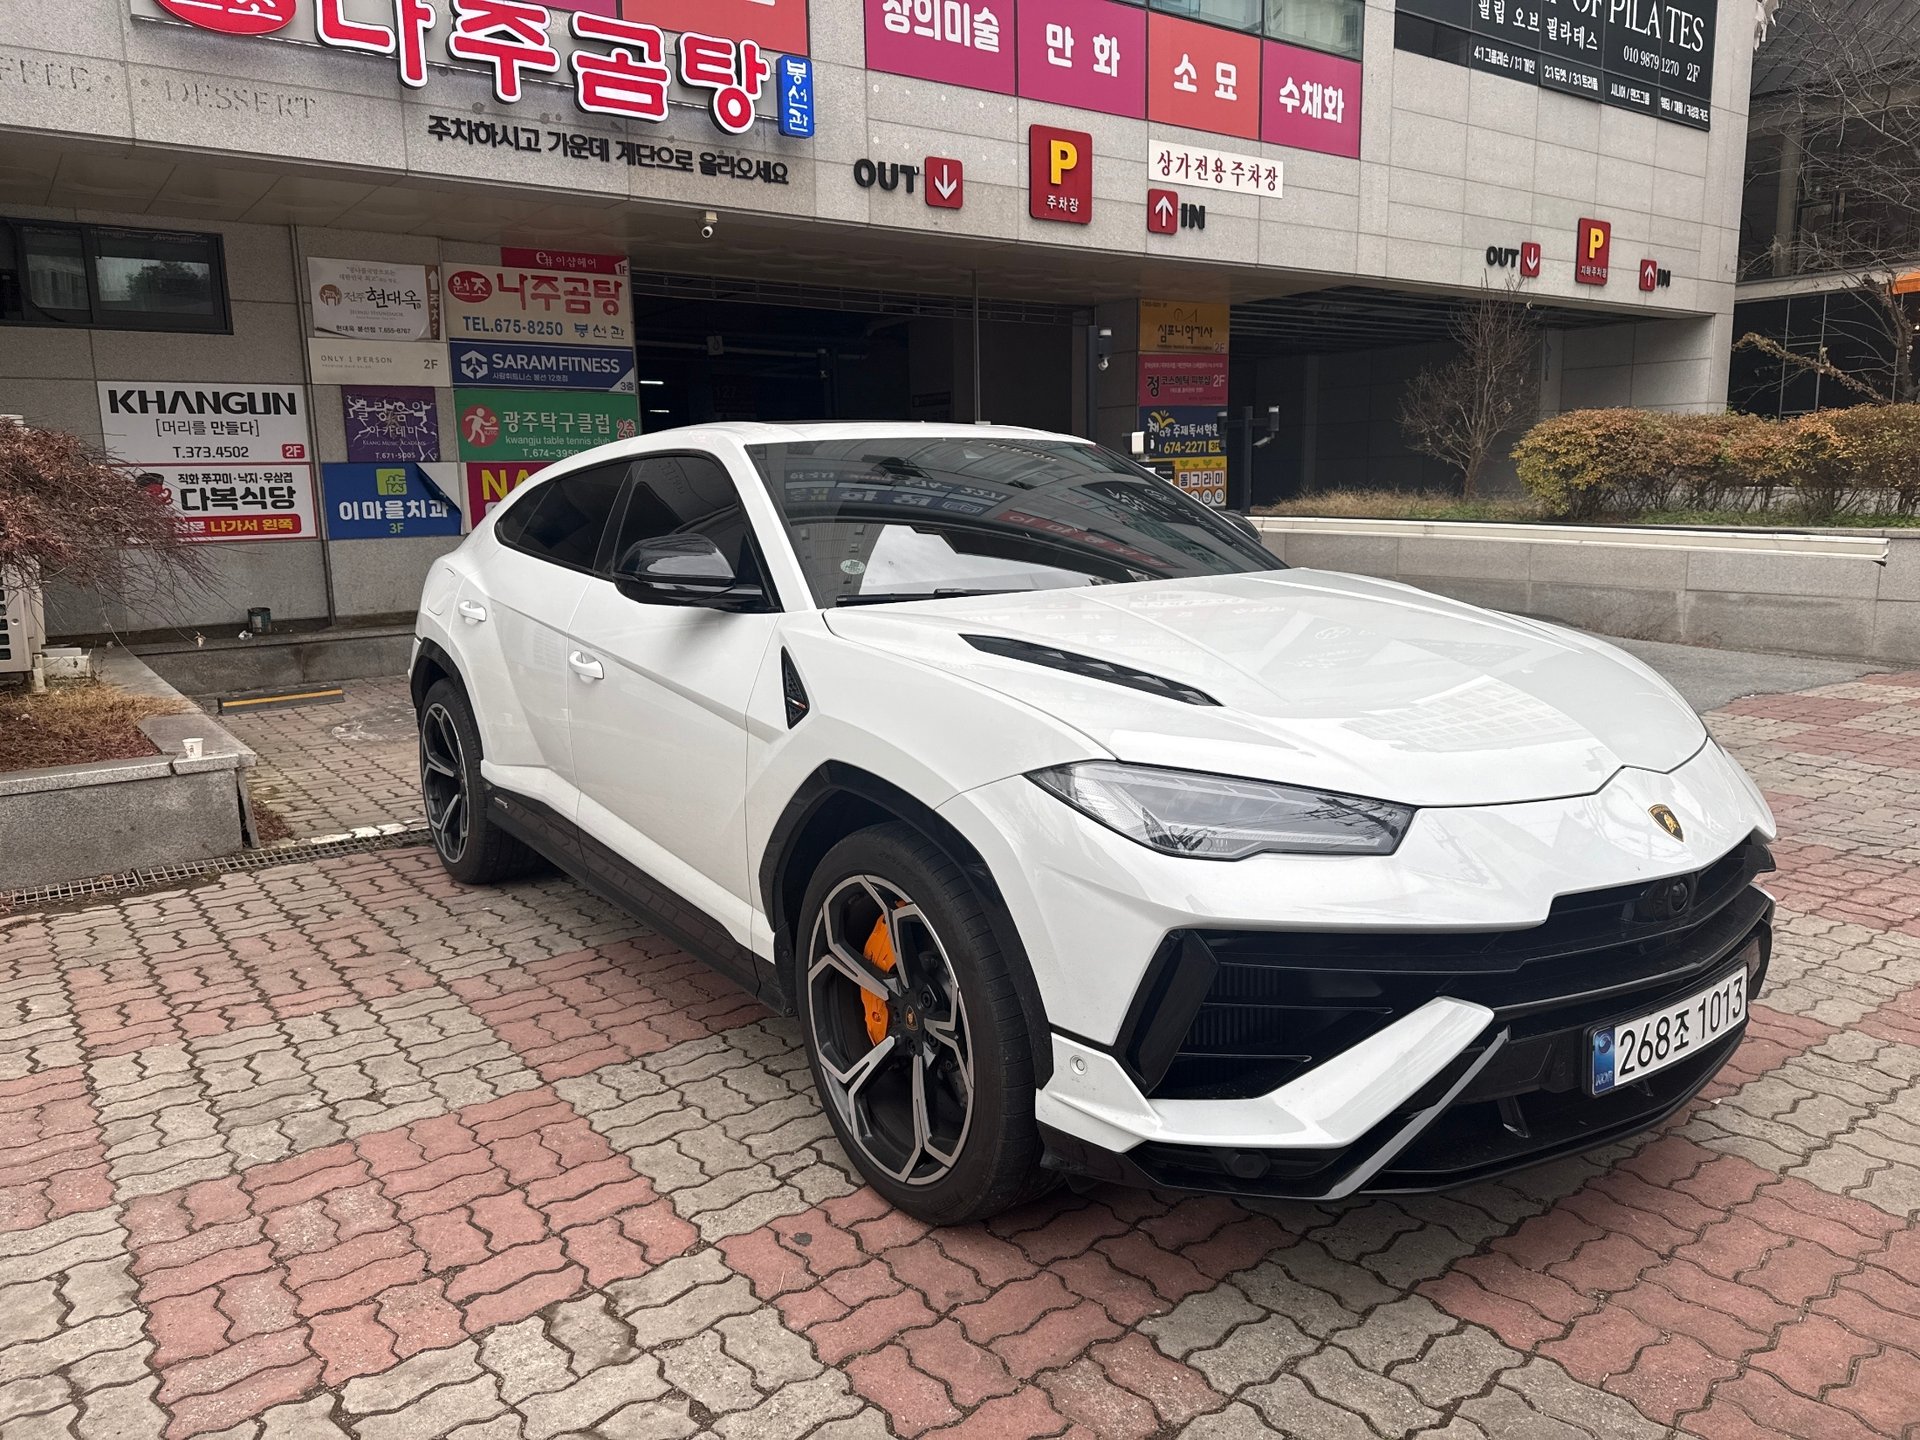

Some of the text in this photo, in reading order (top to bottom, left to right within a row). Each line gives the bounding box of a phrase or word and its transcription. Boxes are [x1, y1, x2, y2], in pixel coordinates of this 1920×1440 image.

[1512, 7, 1540, 32] 오브
[1546, 16, 1598, 50] 필라테스
[1623, 45, 1701, 83] 010 9879 1270 2F
[1279, 77, 1345, 123] 수채화
[428, 115, 789, 184] 주차하시고 가운데 계단으로 올라오세요
[1050, 139, 1078, 185] P
[853, 158, 919, 193] OUT
[1046, 194, 1079, 213] 주차장
[1181, 203, 1205, 230] IN
[1588, 228, 1604, 260] P
[1486, 246, 1519, 268] OUT
[1656, 268, 1671, 288] IN
[365, 286, 421, 310] 현대옥
[452, 272, 623, 316] 원조 나주곰탕
[462, 315, 563, 336] TEL.675-8250
[1157, 324, 1213, 344] 심포니악기사
[356, 356, 393, 364] PERSON
[423, 359, 438, 370] 2F
[620, 381, 634, 391] 3층
[1146, 375, 1160, 397] 정
[1213, 374, 1226, 387] 2F
[108, 389, 297, 415] KHANGUN
[503, 411, 610, 434] 광주탁구클럽
[616, 418, 636, 440] 2층
[1173, 423, 1219, 437] 주제독서학원
[284, 445, 301, 457] 2F
[505, 435, 542, 446] kwangju
[543, 435, 564, 445] table
[566, 436, 592, 445] tennis
[1164, 440, 1207, 454] 674-2271
[172, 446, 249, 459] T.373.4502
[177, 473, 199, 485] 직화
[1180, 472, 1223, 487] 동그라미
[180, 486, 296, 511] 다복식당
[338, 499, 449, 521] 이마을치과
[210, 519, 258, 533] 나가서
[262, 518, 294, 530] 왼쪽
[389, 523, 404, 534] 3F
[1619, 976, 1743, 1076] 268조 1013
